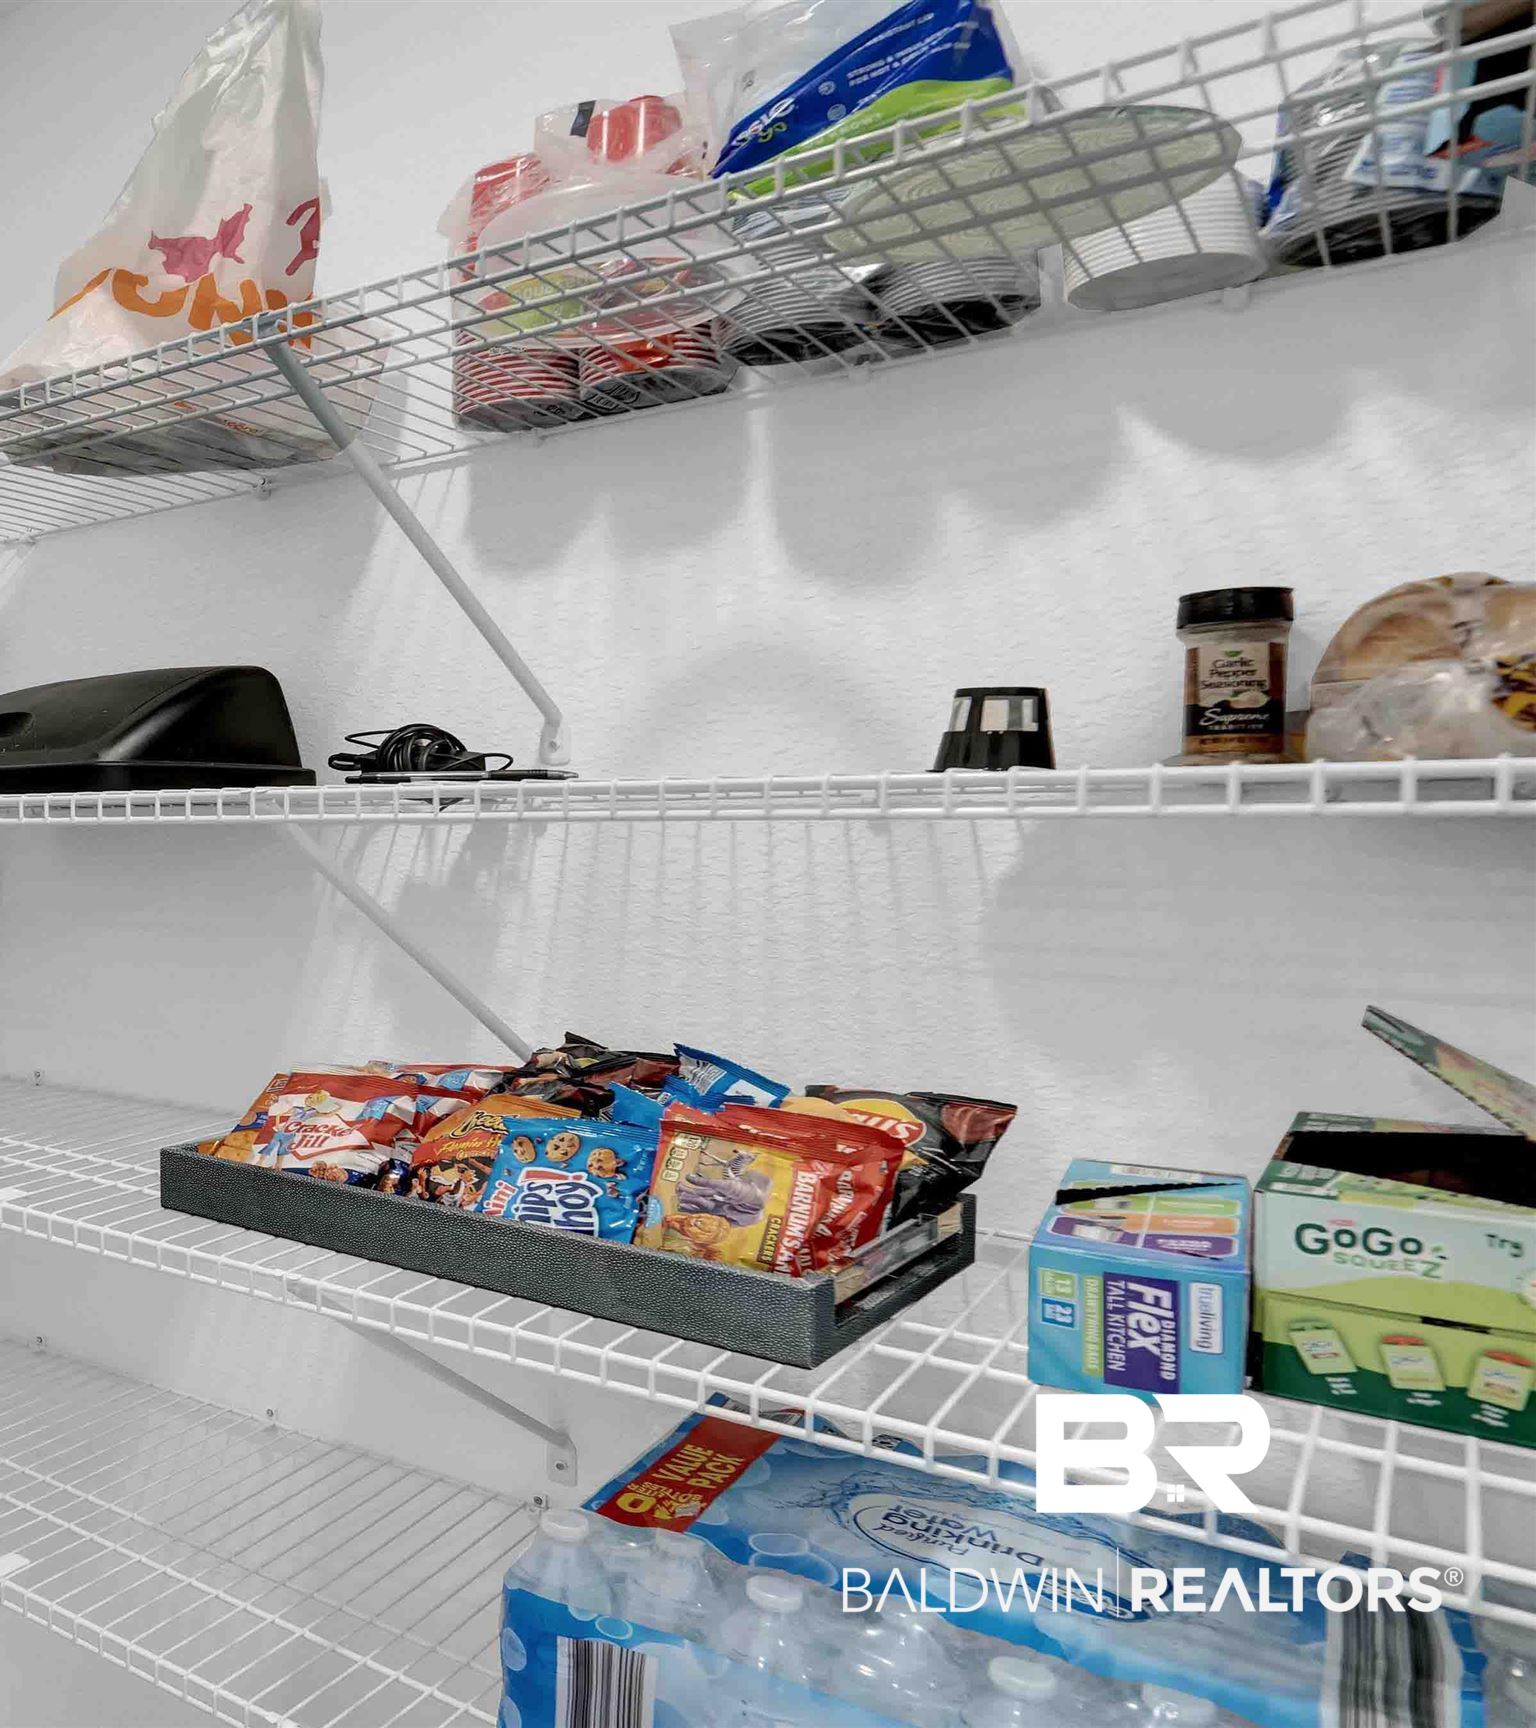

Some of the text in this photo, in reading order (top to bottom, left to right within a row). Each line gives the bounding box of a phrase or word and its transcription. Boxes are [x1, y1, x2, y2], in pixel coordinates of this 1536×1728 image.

[1208, 668, 1258, 679] Pepper
[1211, 656, 1256, 668] Garlic
[287, 1133, 329, 1151] Jill
[513, 1182, 559, 1225] ips
[782, 1170, 816, 1249] BARNUM'S
[761, 1216, 783, 1262] CRACKERS
[1294, 1222, 1423, 1257] GoGo
[1084, 1278, 1099, 1342] DRAWSTRING
[1106, 1280, 1126, 1372] TALL KITCHEN
[1126, 1281, 1174, 1358] Flex
[1159, 1318, 1178, 1381] DIAMOND
[651, 1443, 715, 1483] VALUE
[686, 1453, 746, 1489] PACK
[640, 1481, 704, 1502] BOTTLES
[870, 1522, 970, 1556] Purified
[882, 1512, 1045, 1567] Drinking
[886, 1504, 998, 1543] Water
